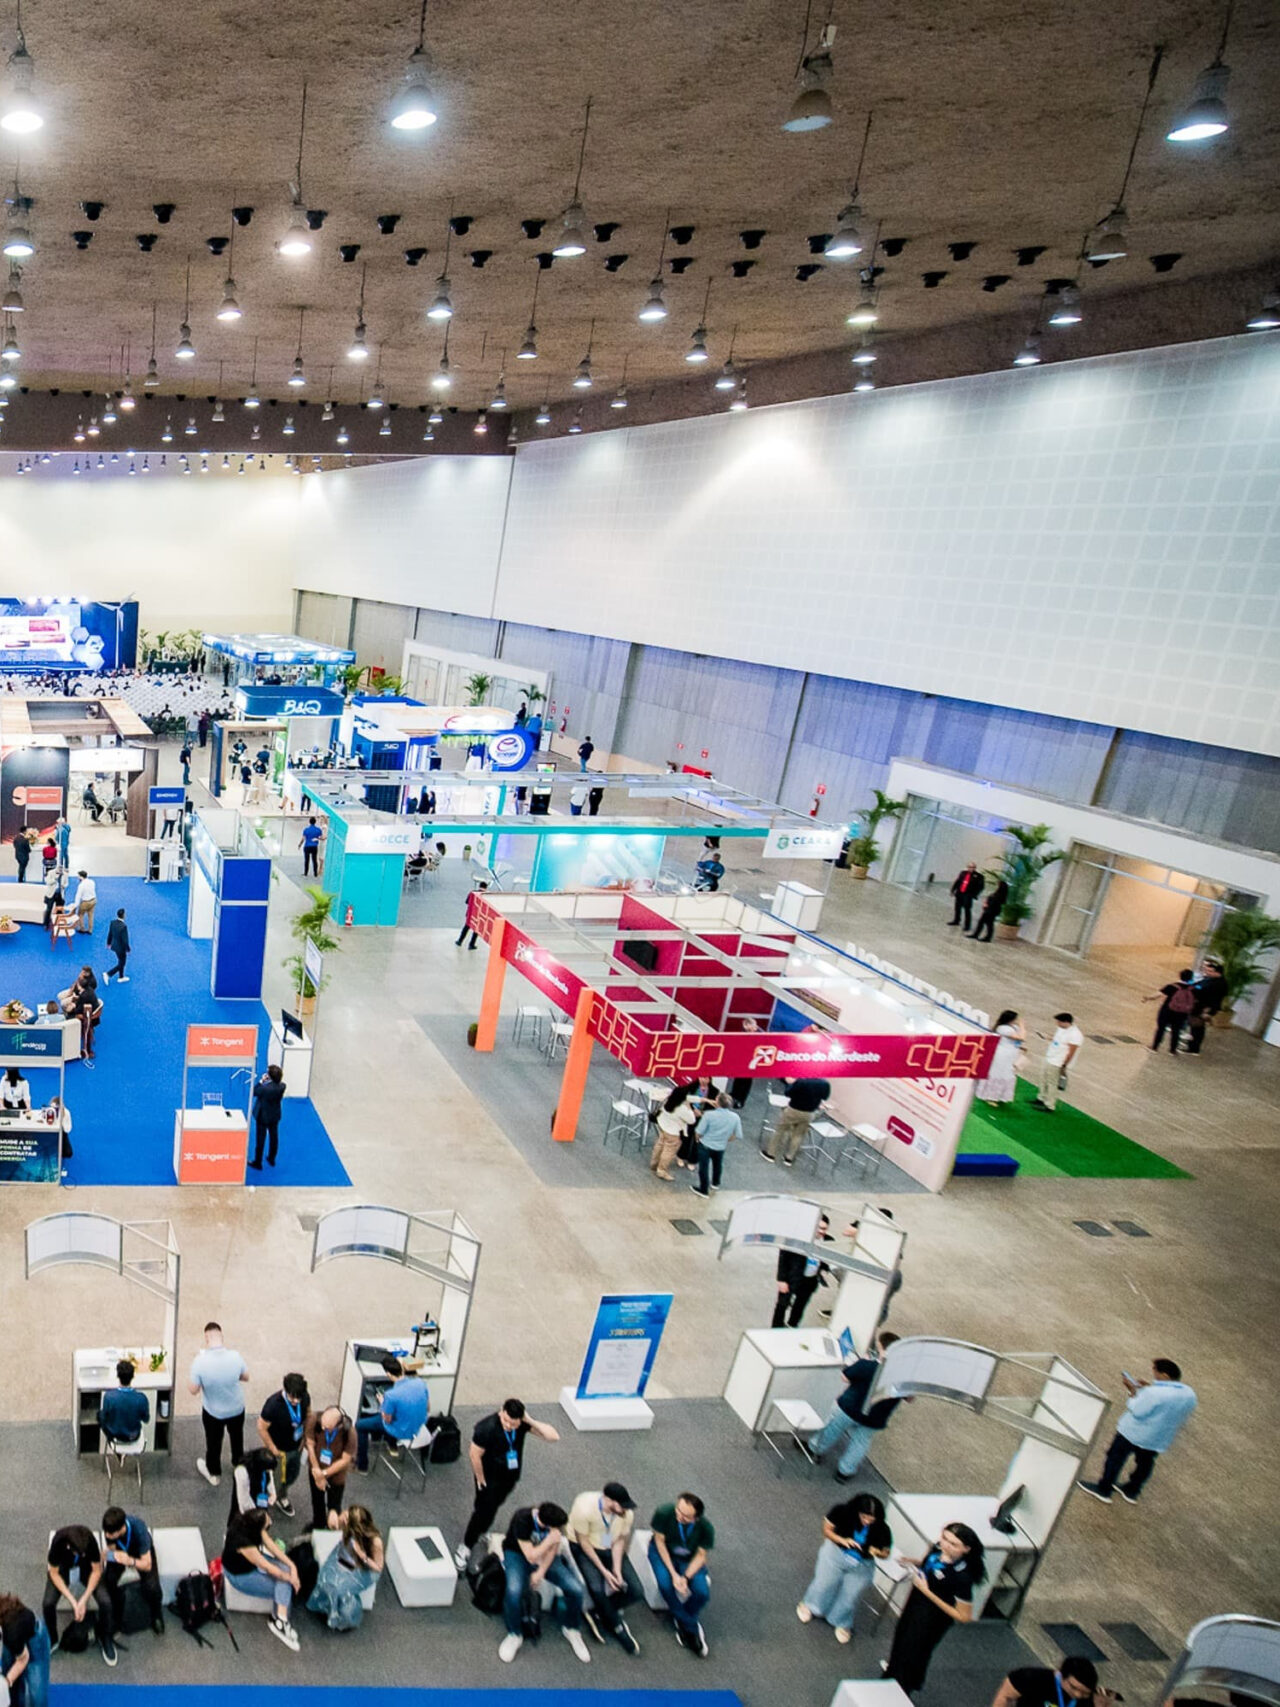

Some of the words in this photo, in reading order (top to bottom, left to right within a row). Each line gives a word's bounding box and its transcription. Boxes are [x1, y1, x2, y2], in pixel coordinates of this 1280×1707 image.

[276, 699, 322, 715] B&Q
[211, 1037, 244, 1047] Tangent
[776, 1050, 812, 1062] Banco
[812, 1050, 827, 1062] do
[829, 1050, 881, 1063] Nordeste
[925, 1077, 956, 1103] Sol
[196, 1152, 230, 1161] Tangent
